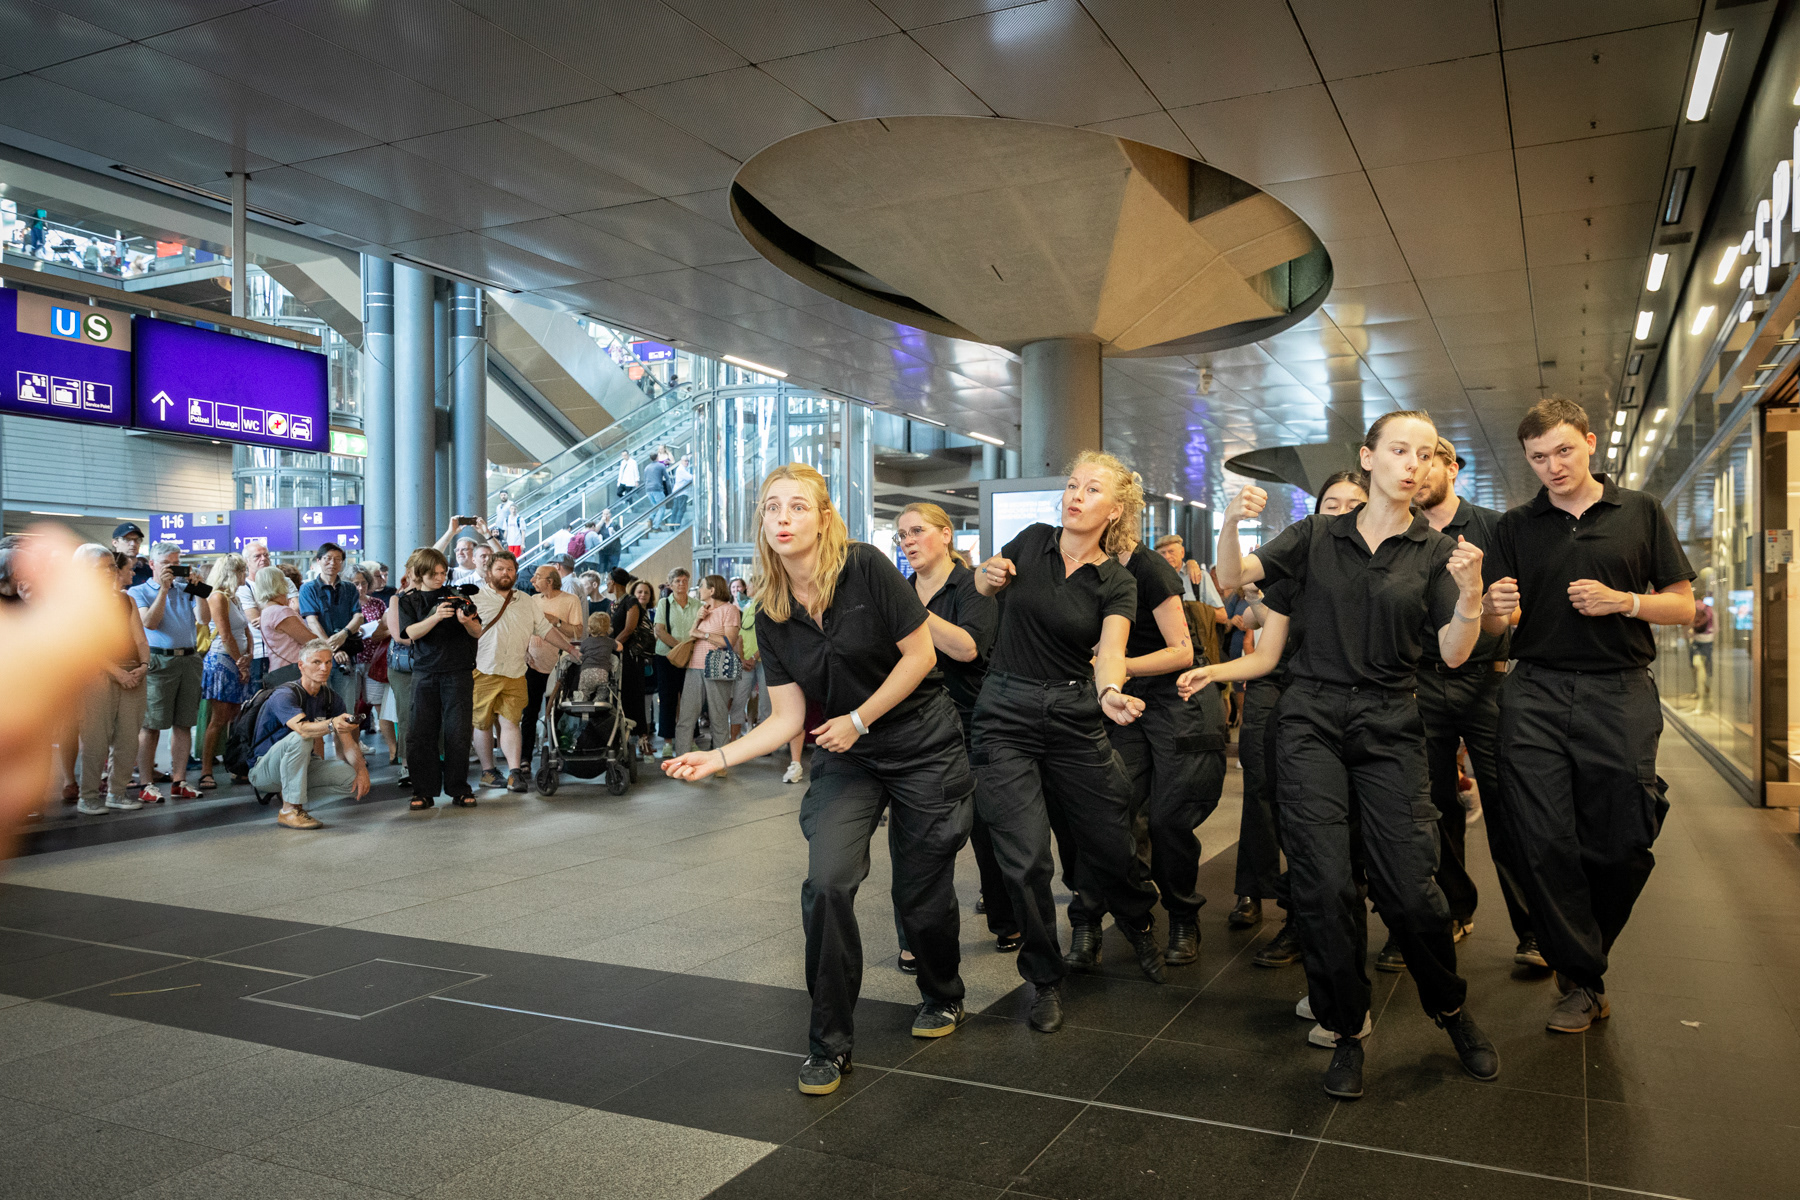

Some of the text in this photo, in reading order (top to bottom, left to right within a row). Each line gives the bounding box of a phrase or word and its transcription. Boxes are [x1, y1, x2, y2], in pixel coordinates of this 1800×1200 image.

[1739, 118, 1800, 323] ESP
[56, 309, 108, 340] U S
[190, 415, 209, 424] Polizei
[217, 418, 238, 429] Lounge
[243, 418, 260, 431] WC
[160, 514, 184, 528] 11-16
[200, 515, 207, 525] S
